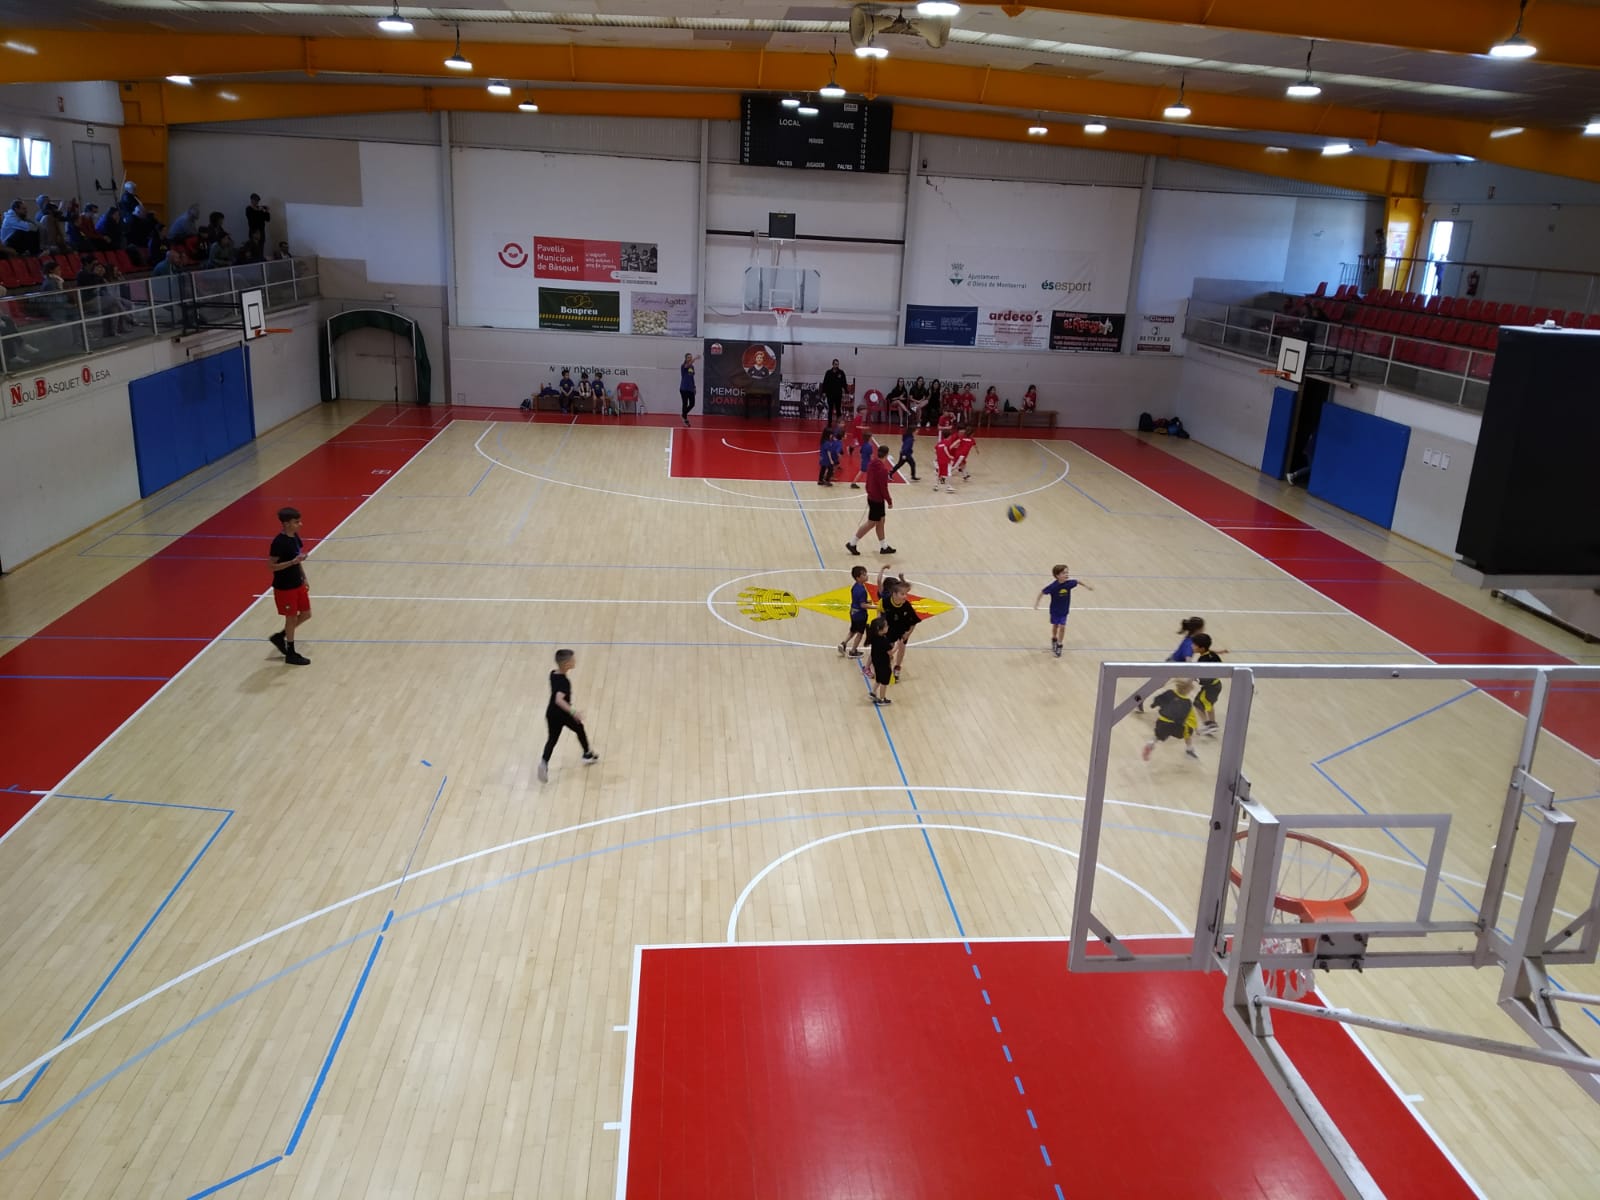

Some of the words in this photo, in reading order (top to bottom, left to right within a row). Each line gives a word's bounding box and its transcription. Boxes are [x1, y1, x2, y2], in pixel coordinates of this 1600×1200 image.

[537, 254, 573, 263] Municipal
[560, 306, 598, 315] Bonpreu
[989, 310, 1042, 322] ardeco's
[9, 383, 35, 406] NOU
[81, 365, 111, 386] OLESA
